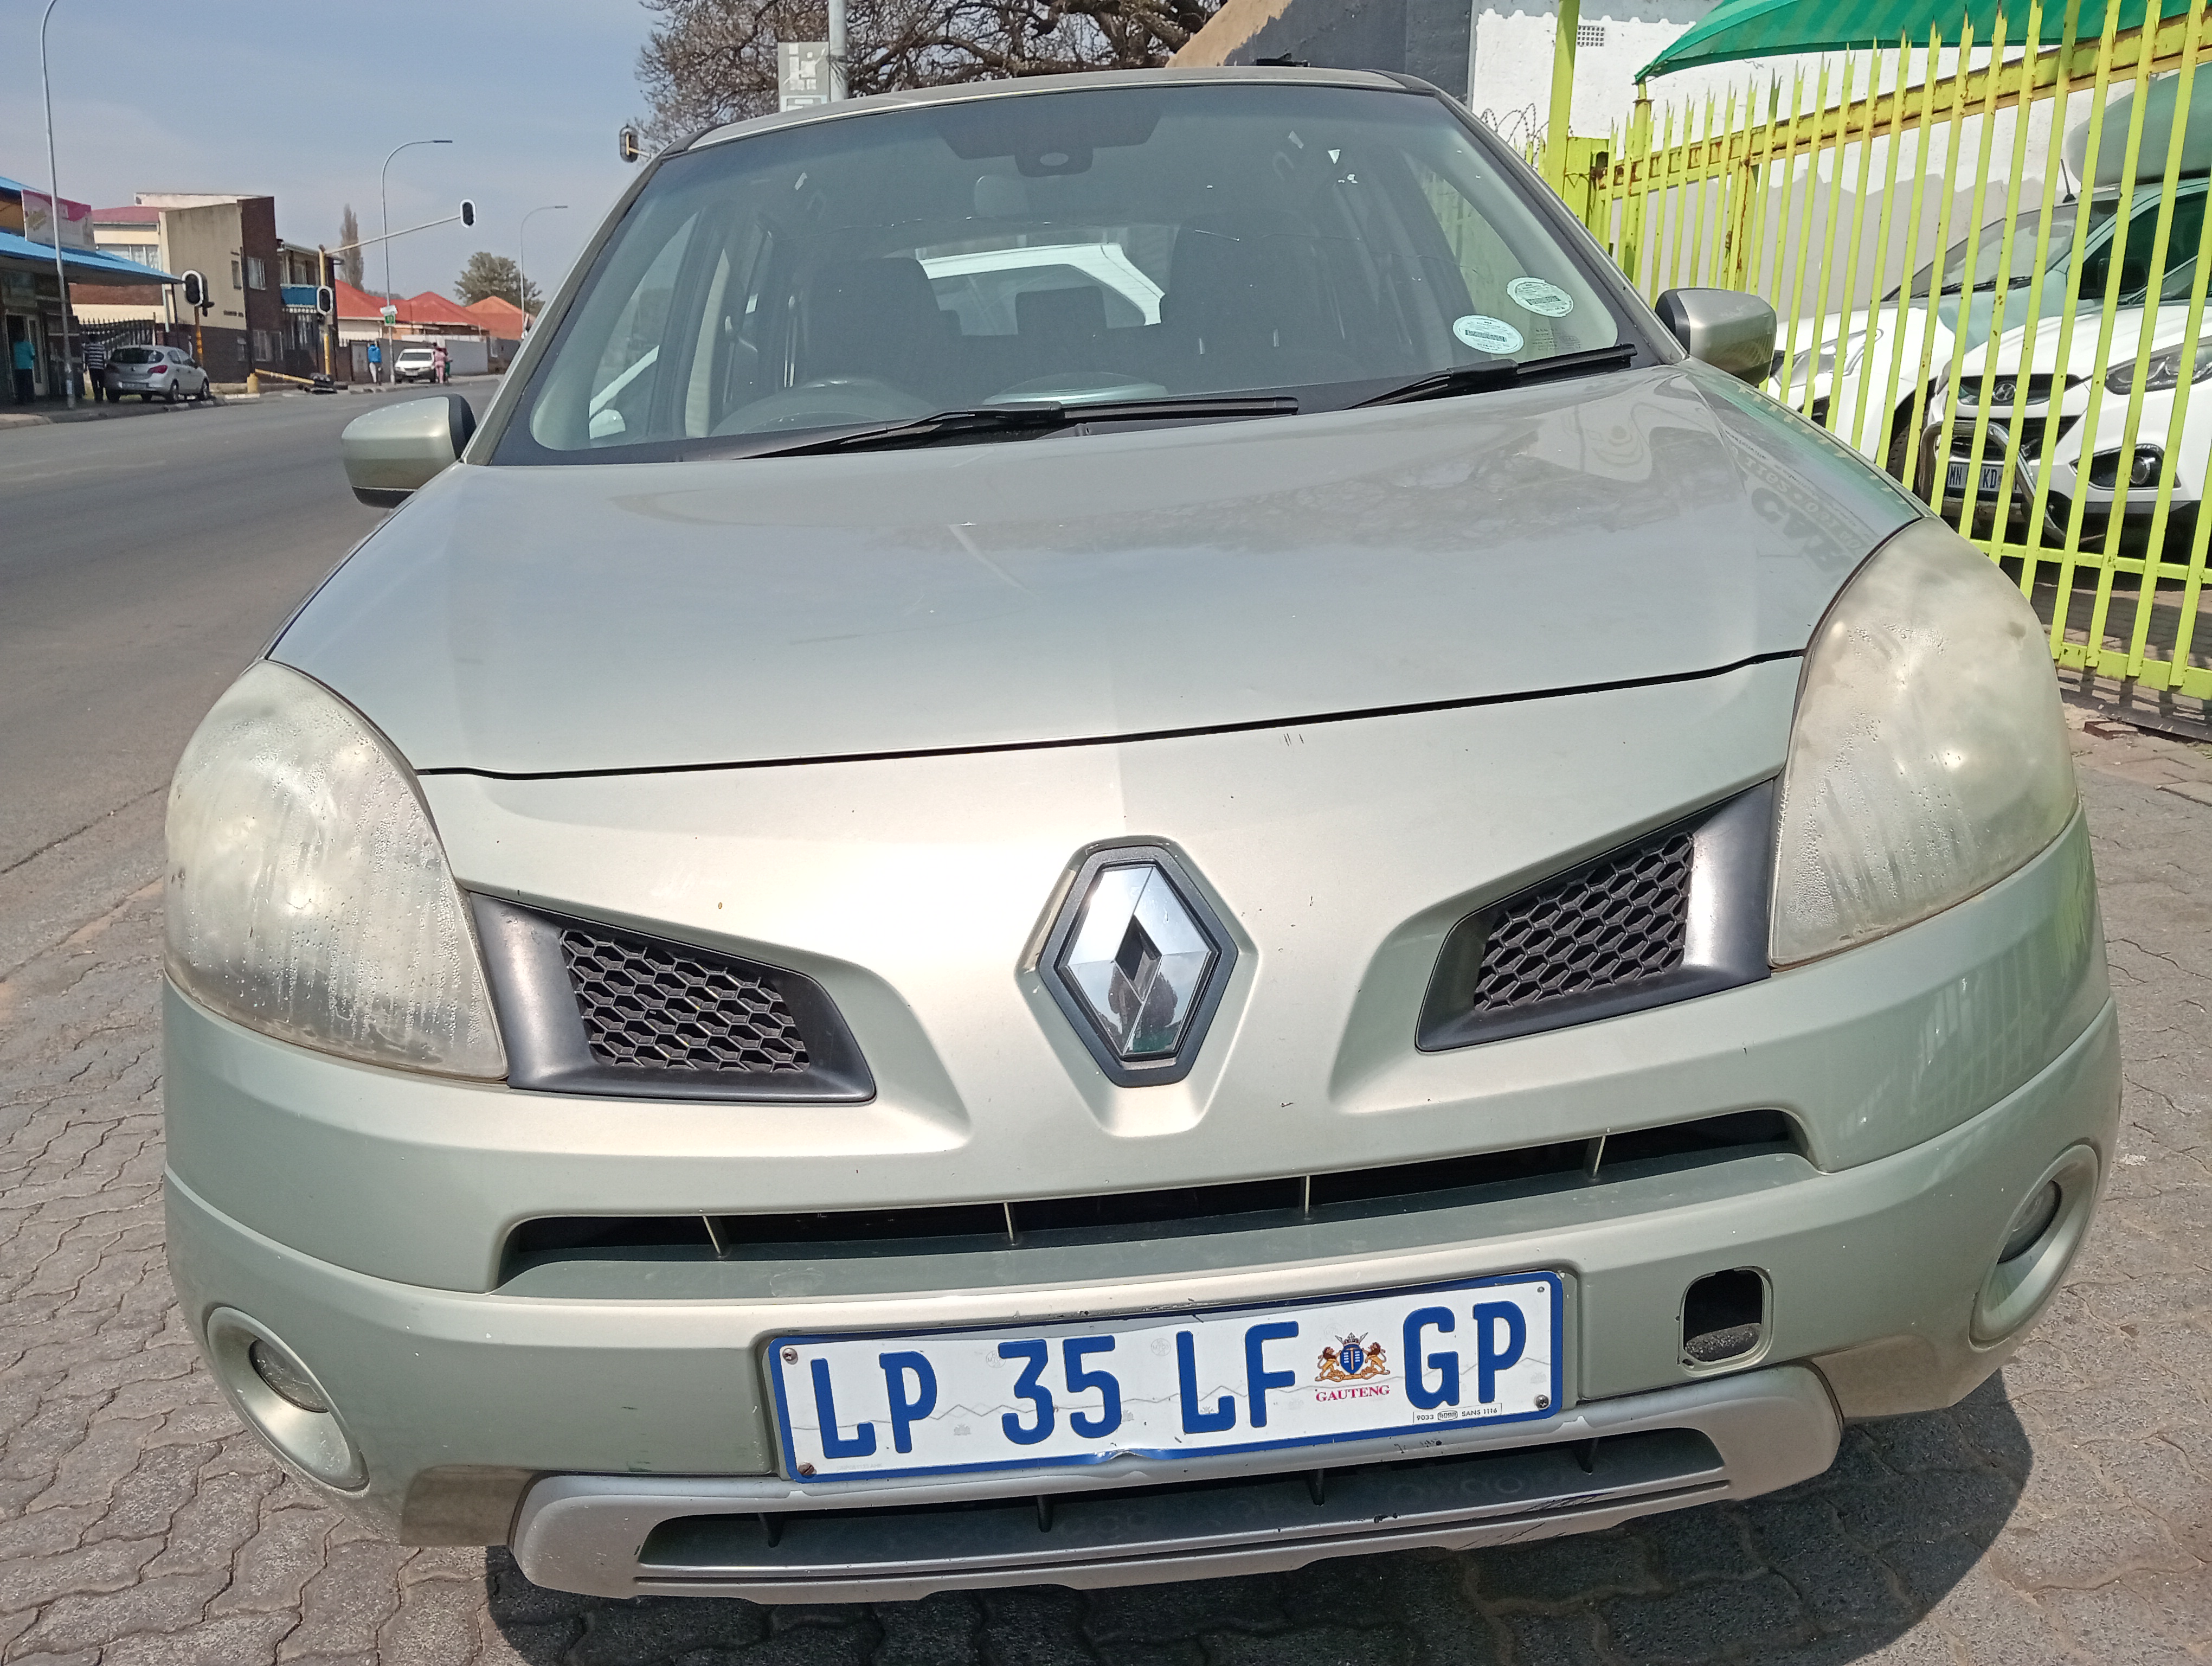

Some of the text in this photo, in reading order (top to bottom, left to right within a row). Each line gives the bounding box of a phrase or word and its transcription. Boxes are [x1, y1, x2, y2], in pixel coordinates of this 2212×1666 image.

[1983, 468, 1997, 488] KD
[811, 1300, 1526, 1459] LP 35 LF GP
[1316, 1385, 1390, 1401] GAUTENG
